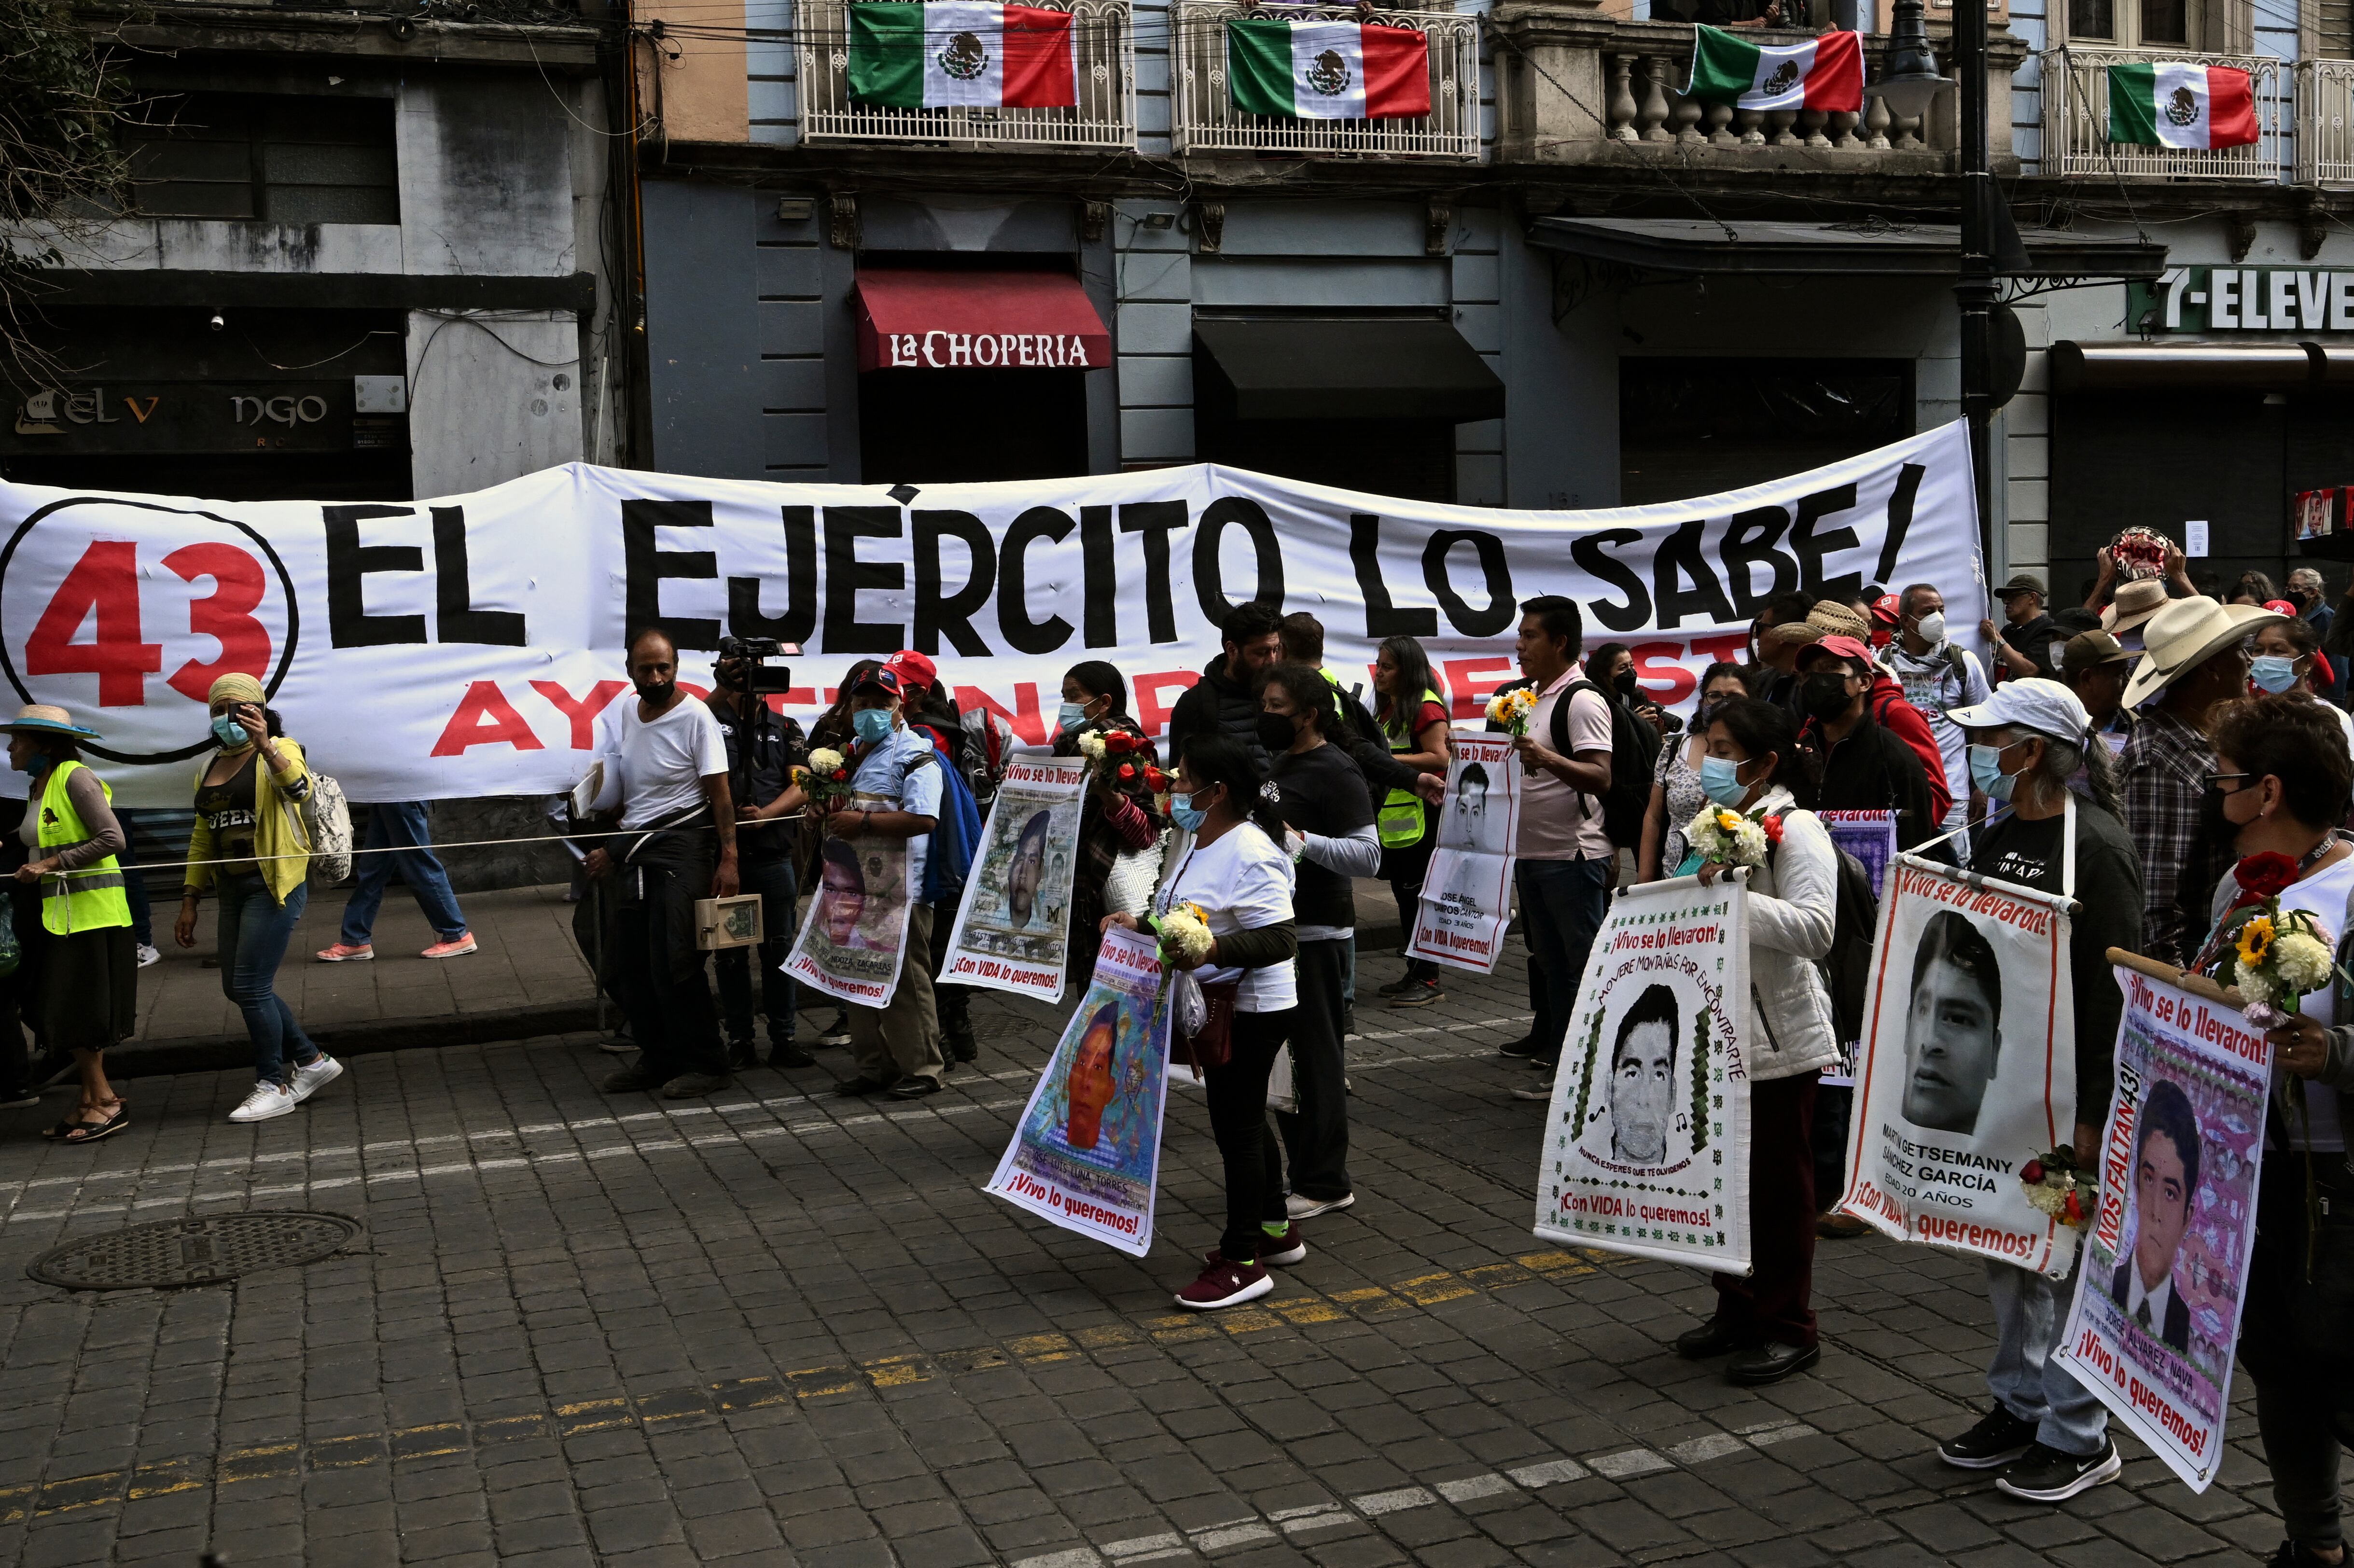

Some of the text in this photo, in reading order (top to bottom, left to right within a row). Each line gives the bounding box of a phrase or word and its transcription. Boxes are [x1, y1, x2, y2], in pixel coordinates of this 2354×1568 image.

[922, 331, 1089, 368] CHOPERIA
[25, 463, 1926, 708] 43 EL EJÉRCITO LO SABE!
[1460, 748, 1470, 760] se
[1032, 768, 1044, 783] se
[1045, 767, 1054, 783] lo
[208, 809, 256, 829] UEEN
[1439, 917, 1452, 925] EDAD
[1461, 920, 1474, 929] AÑOS
[1460, 908, 1484, 920] CANTOR
[1934, 883, 1956, 902] se
[1951, 885, 1974, 907] lo
[1969, 890, 2050, 936] llevaron!
[1115, 948, 1128, 964] se
[1126, 946, 1136, 967] lo
[1434, 929, 1448, 946] VIDA
[1455, 935, 1490, 956] queremos!
[1610, 922, 1719, 955] ¡Vivo se lo llevaron!
[795, 957, 818, 978] ¡Vivo
[829, 976, 885, 998] queremos!
[953, 957, 1058, 989] ¡Con VIDA lo queremos!
[1598, 952, 1747, 1083] MOVERE MONTAÑAS POR ENCONTRARTE
[2131, 974, 2154, 1013] ¡Vivo
[2155, 996, 2173, 1023] se
[2176, 997, 2191, 1031] lo
[2195, 1005, 2268, 1066] llevaron!
[1578, 1145, 1691, 1177] NUNCA ESPERES QUE TE OLVIDEMOS
[1883, 1123, 2013, 1174] MARTÍN GETSEMANY
[2097, 1060, 2140, 1251] NOS FALTAN 43!
[1051, 1158, 1067, 1173] LUIS
[1071, 1166, 1091, 1182] LUNA
[1097, 1174, 1128, 1193] TORRES
[1883, 1146, 1997, 1193] SÁNCHEZ GARCÍA
[1006, 1173, 1139, 1235] ¡Vivo lo queremos!
[1885, 1172, 1973, 1208] EDAD 20 AÑOS
[1560, 1192, 1711, 1228] ¡Con VIDA lo queremos!
[1852, 1181, 1881, 1211] ¡Con
[1918, 1214, 2037, 1260] queremos!
[2105, 1306, 2125, 1337] JORGE
[2171, 1360, 2193, 1390] NAVA
[2076, 1328, 2208, 1458] ¡Vivo lo queremos!
